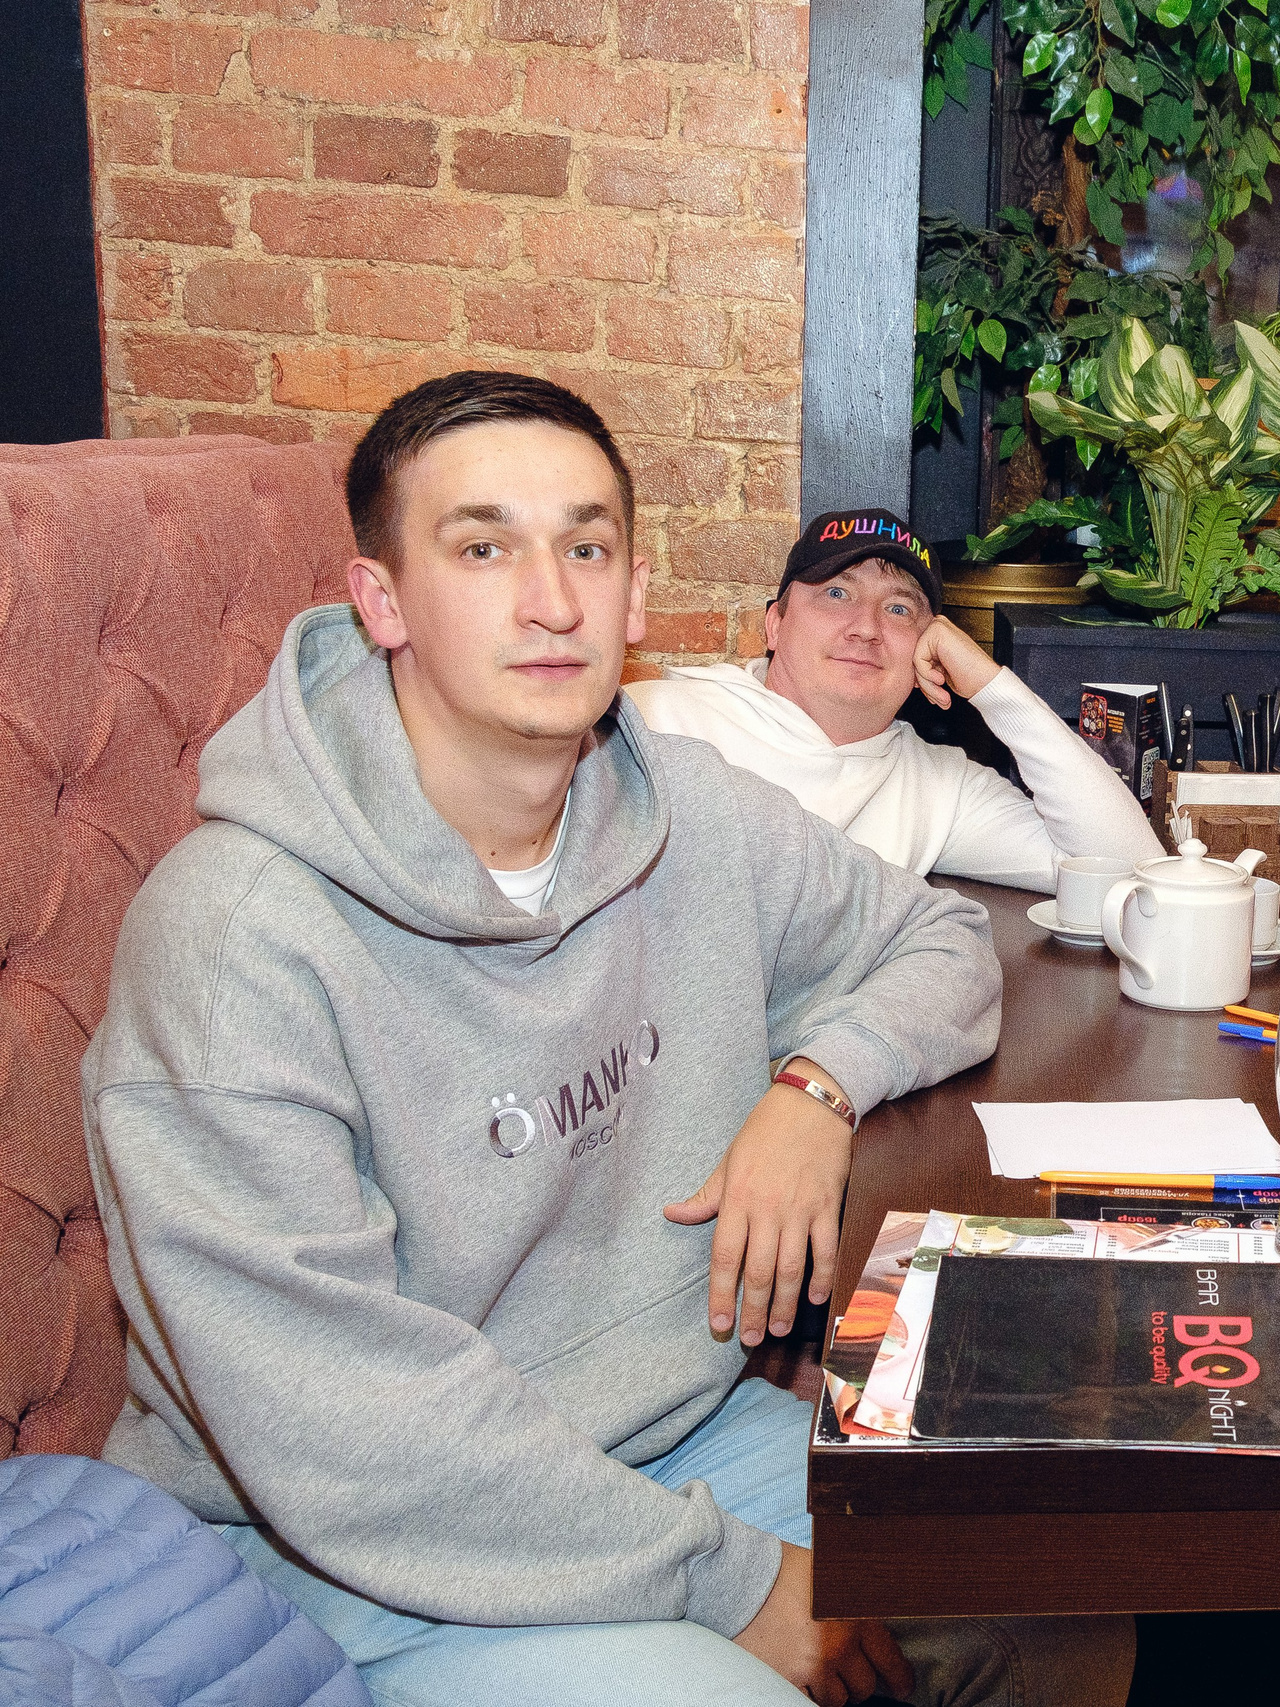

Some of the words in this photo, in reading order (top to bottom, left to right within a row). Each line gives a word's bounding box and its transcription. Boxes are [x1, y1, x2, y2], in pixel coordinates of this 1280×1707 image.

[819, 518, 931, 569] ДУШНИЛА
[1196, 1269, 1219, 1306] BAR
[1151, 1310, 1168, 1325] to
[1152, 1326, 1169, 1345] be
[1149, 1345, 1171, 1385] quality
[1172, 1315, 1261, 1388] BQ
[1208, 1389, 1247, 1442] NIGHT
